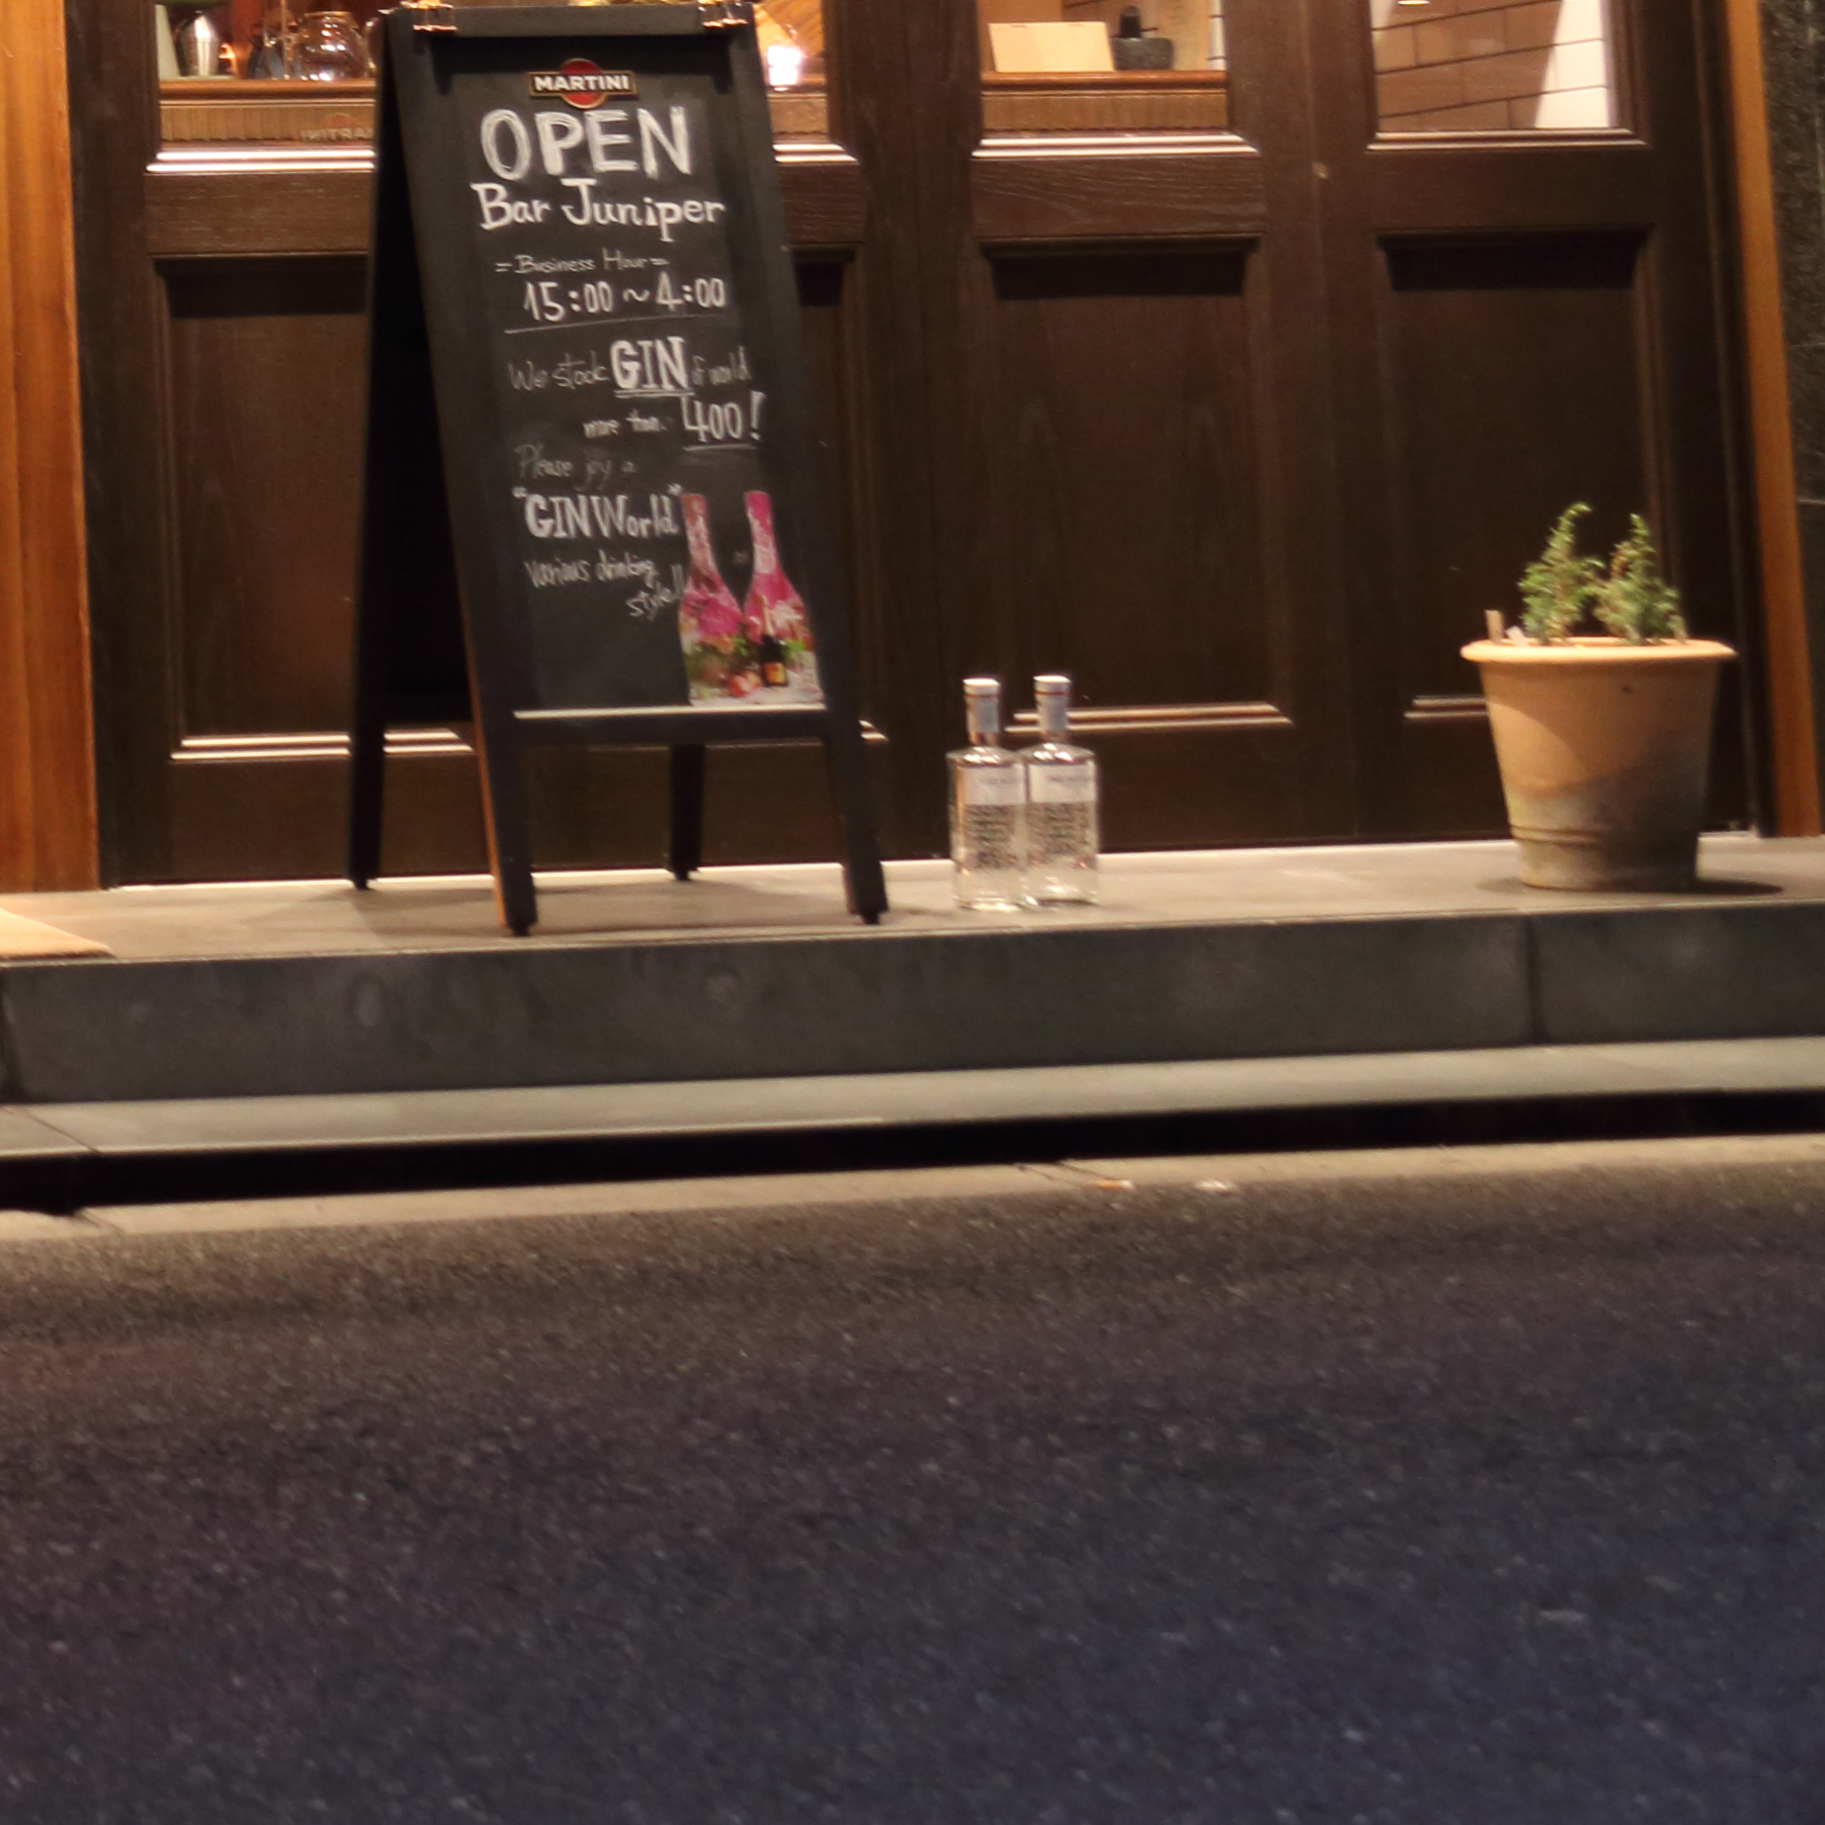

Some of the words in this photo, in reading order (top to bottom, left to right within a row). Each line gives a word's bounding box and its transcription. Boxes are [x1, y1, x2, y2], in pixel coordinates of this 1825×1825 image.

[534, 74, 630, 92] MARTINI
[480, 106, 693, 180] OPEN
[470, 182, 551, 230] Bar
[561, 178, 726, 243] Juniper
[515, 254, 596, 273] Business
[524, 280, 614, 322] 15:00
[655, 272, 726, 312] 4:00
[508, 360, 548, 391] We
[610, 336, 690, 391] GIN
